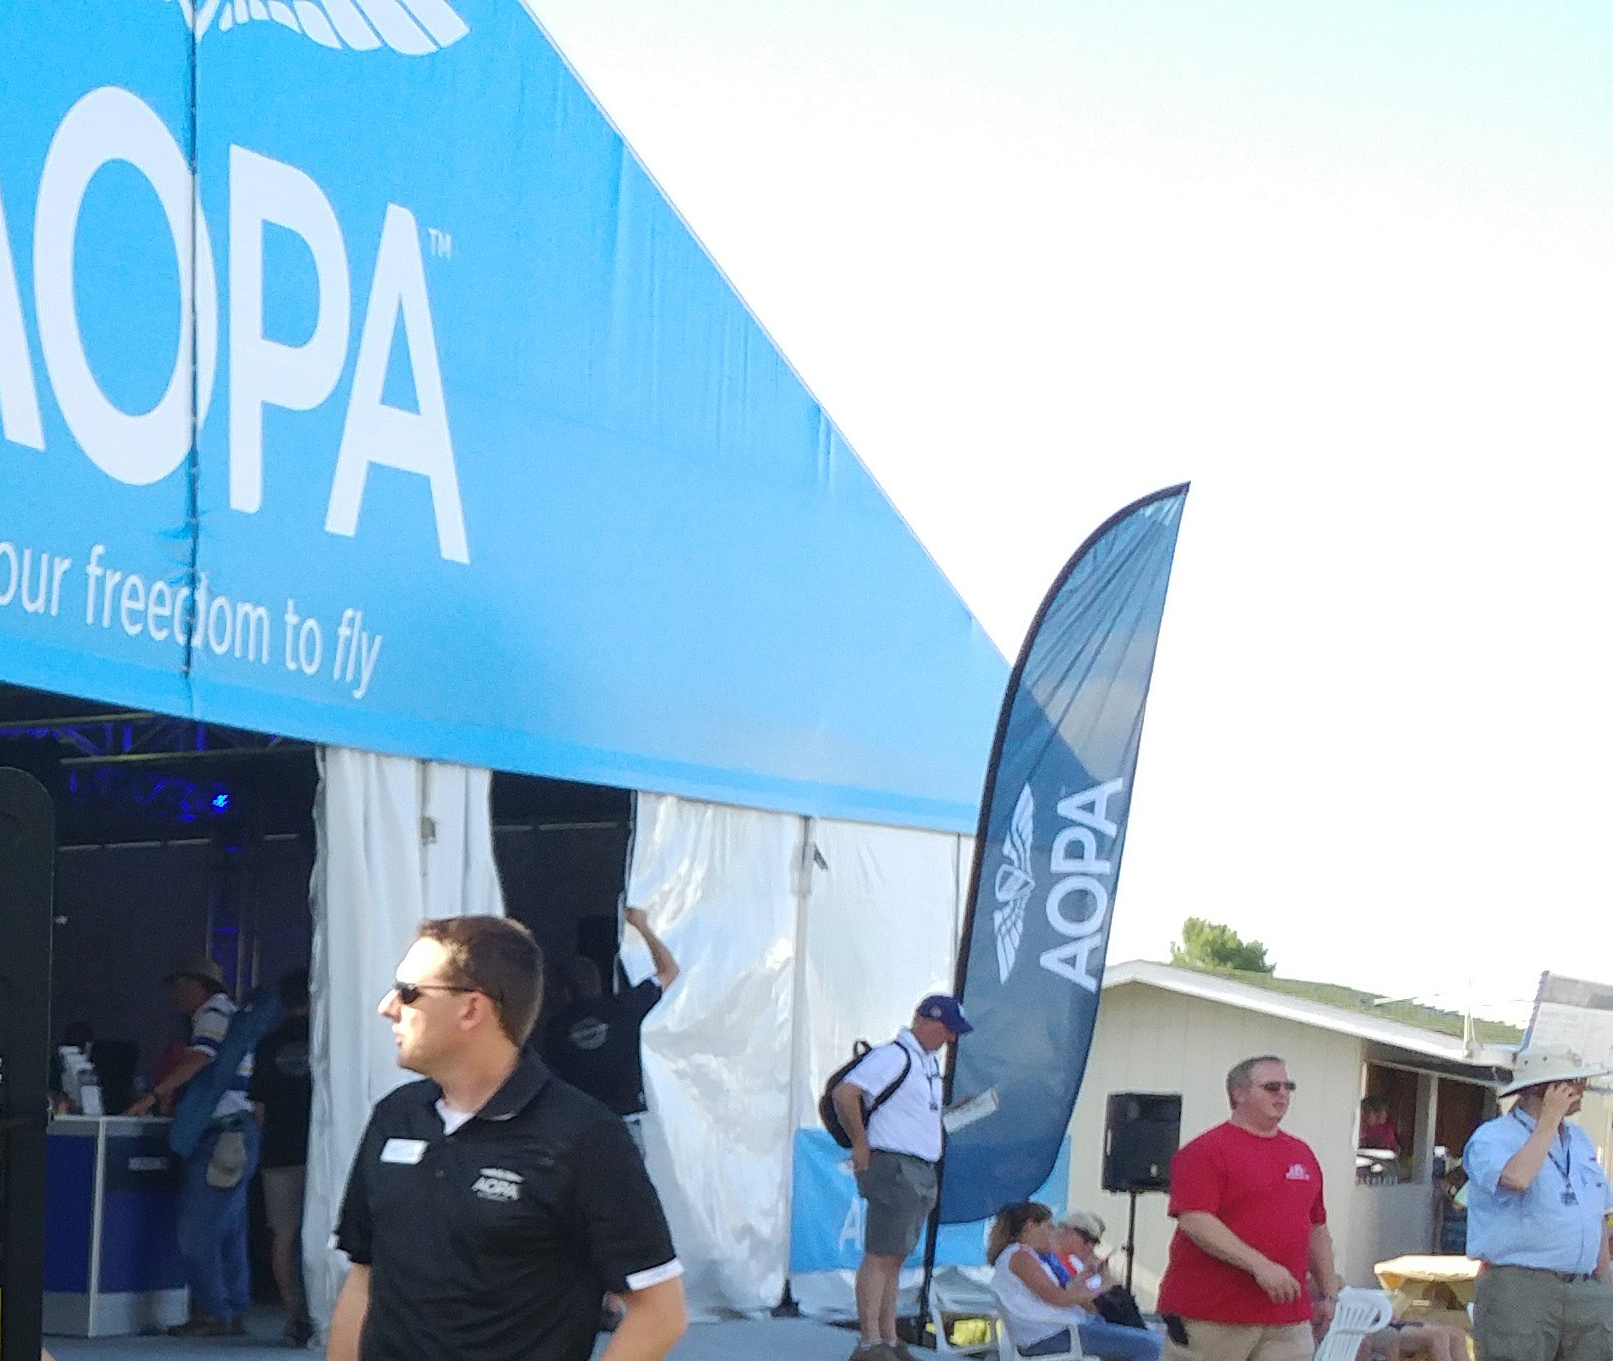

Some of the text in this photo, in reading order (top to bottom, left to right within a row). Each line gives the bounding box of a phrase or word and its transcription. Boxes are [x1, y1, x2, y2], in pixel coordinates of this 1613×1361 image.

[84, 543, 271, 665] freedom
[284, 598, 323, 676] to
[333, 607, 383, 700] fly
[1039, 776, 1124, 994] AOPA
